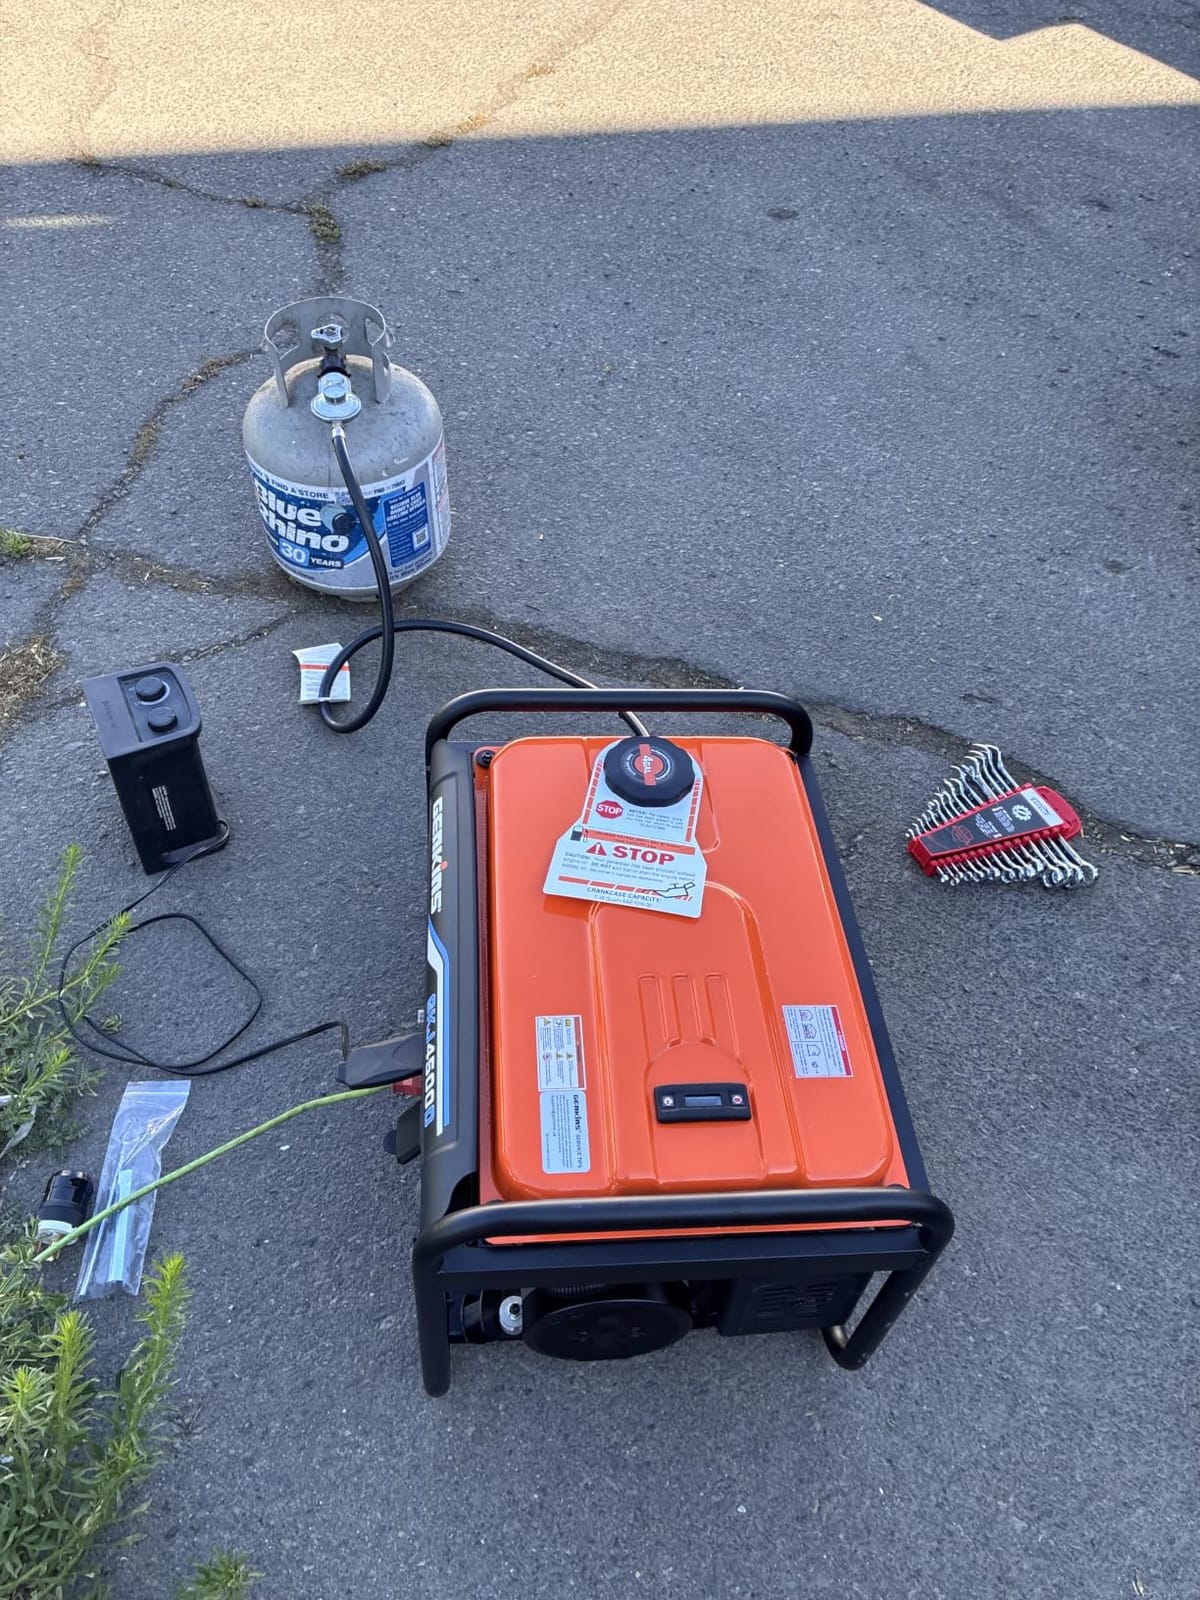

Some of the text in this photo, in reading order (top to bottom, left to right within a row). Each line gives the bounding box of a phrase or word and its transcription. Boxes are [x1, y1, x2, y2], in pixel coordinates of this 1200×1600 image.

[254, 478, 321, 527] Blue
[298, 489, 329, 499] STORE
[259, 502, 349, 553] Rhino
[280, 543, 306, 564] 30
[310, 556, 342, 568] YEARS
[597, 803, 622, 816] STOP
[612, 845, 675, 865] STOP
[586, 886, 626, 897] CRANKCASE
